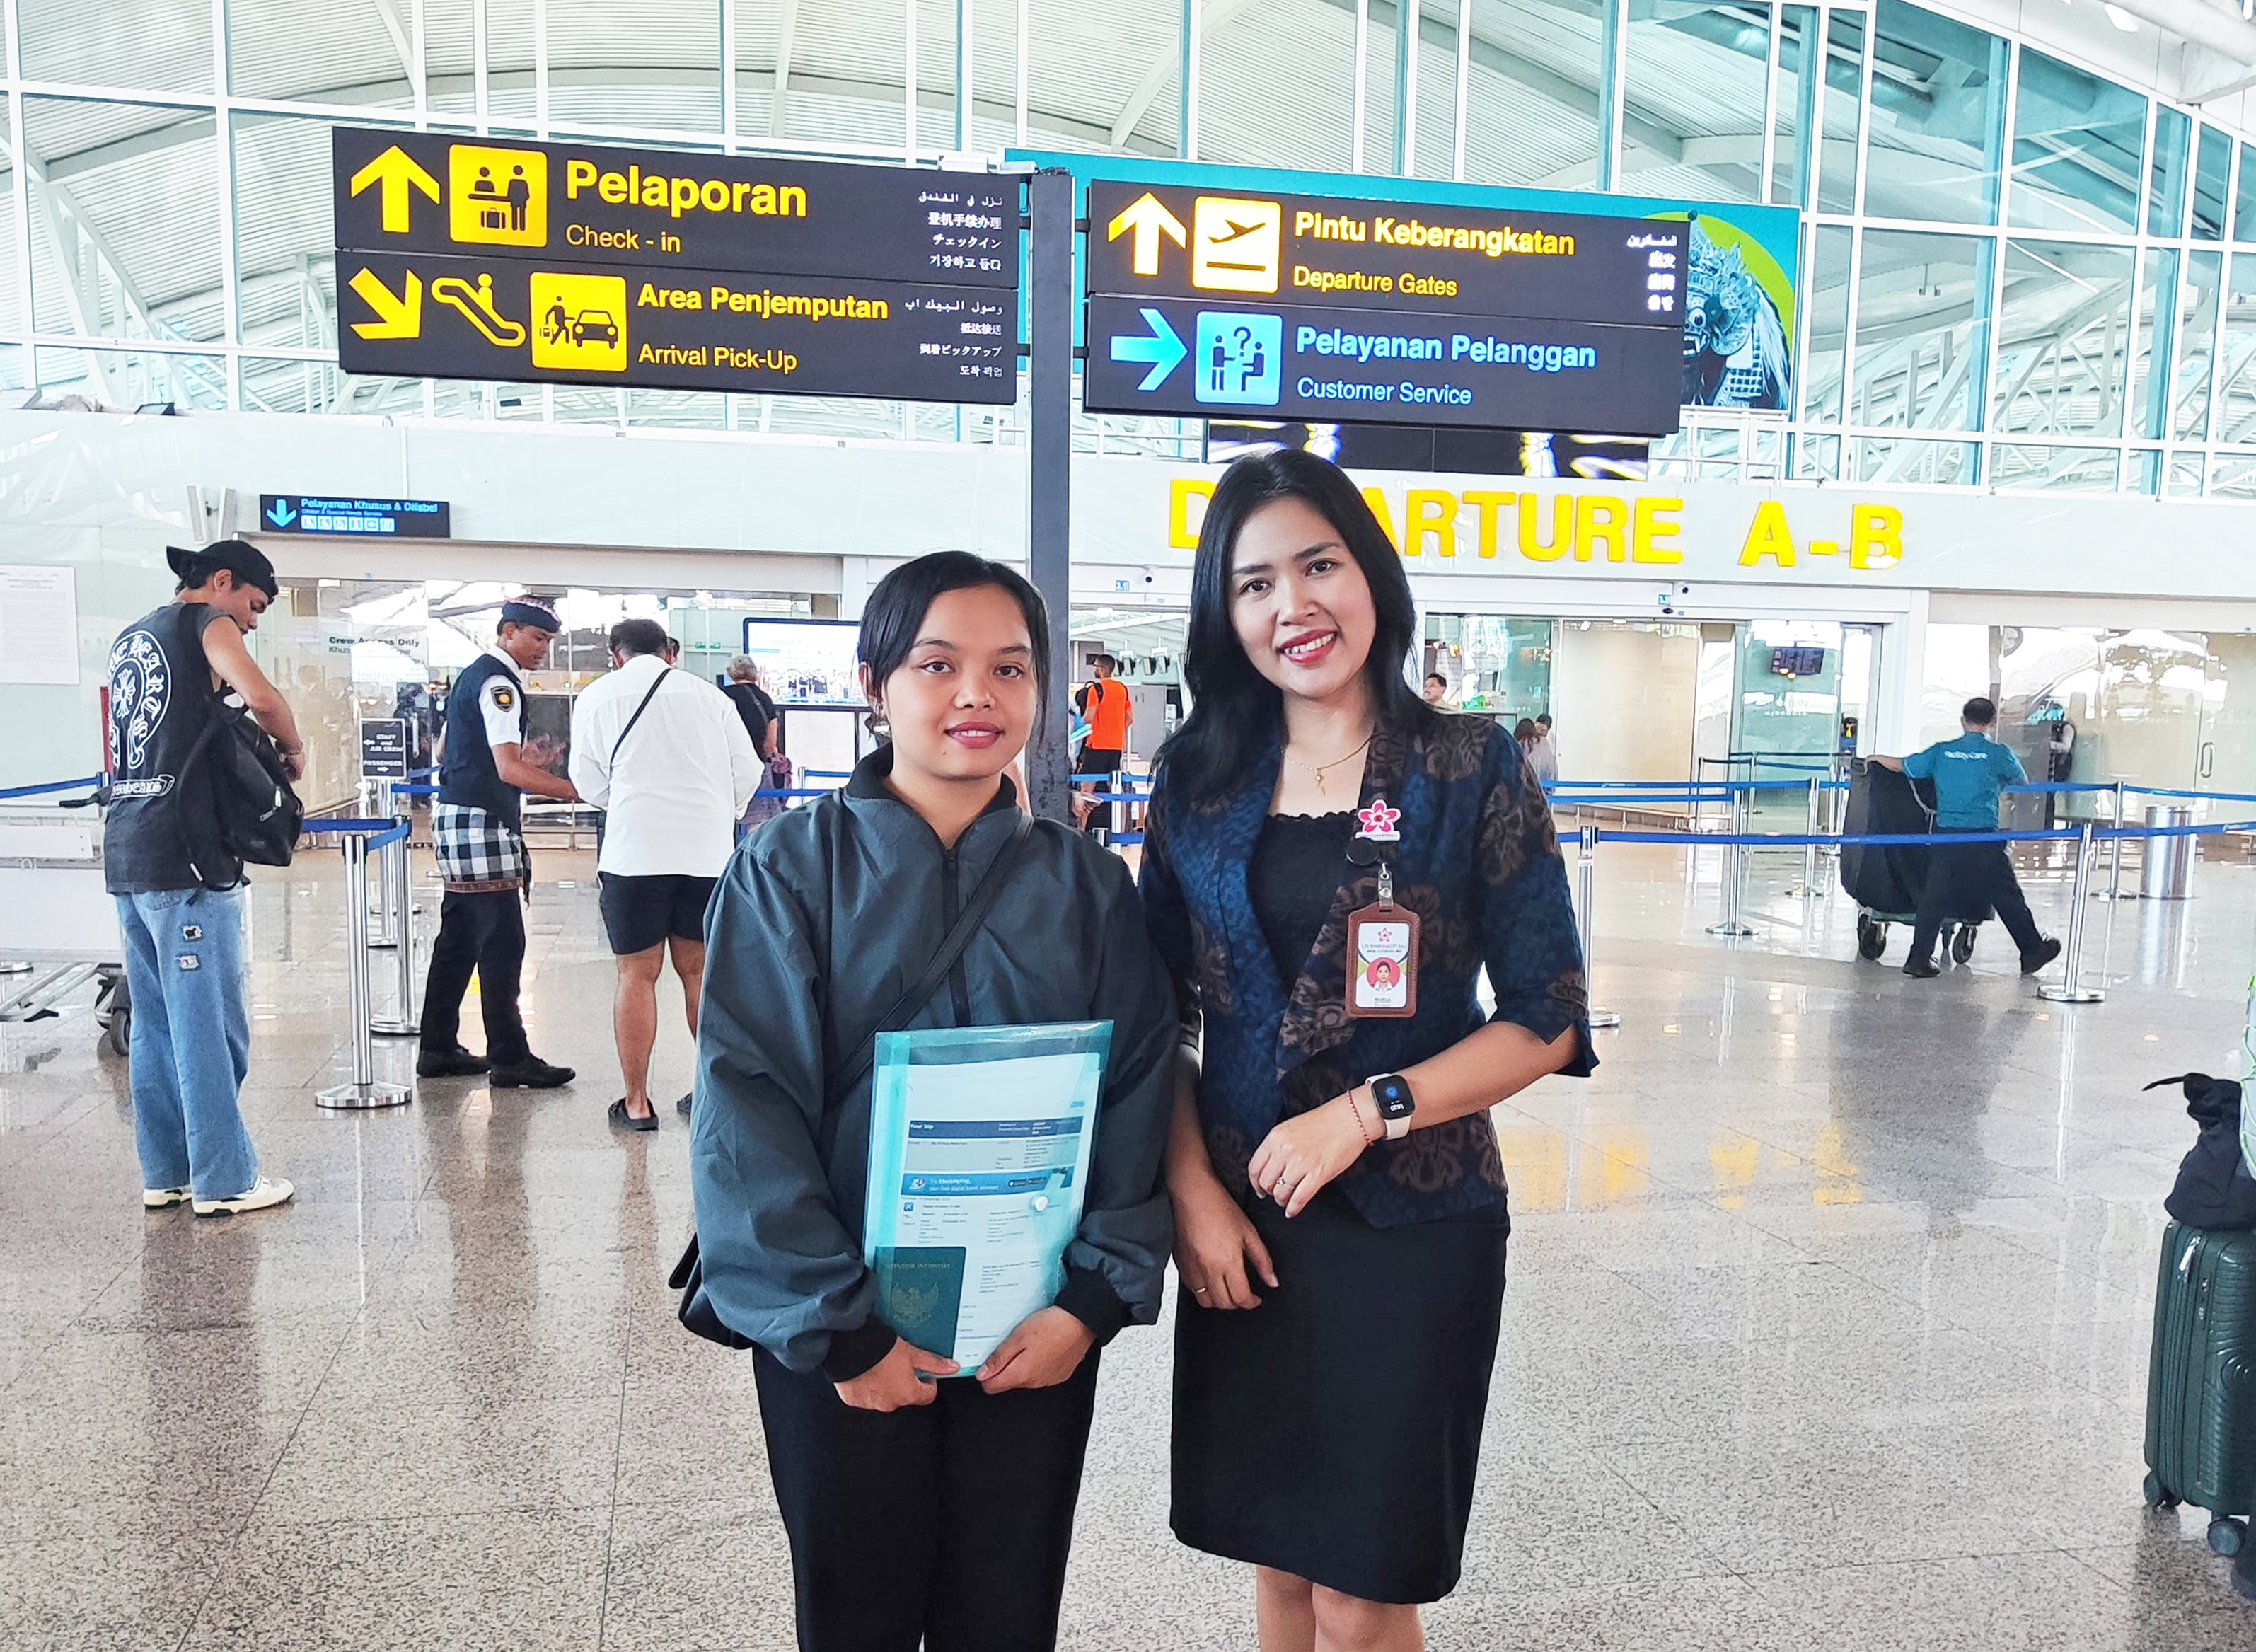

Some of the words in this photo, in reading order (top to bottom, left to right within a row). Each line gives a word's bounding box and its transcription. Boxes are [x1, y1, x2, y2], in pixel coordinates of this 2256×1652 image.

[567, 160, 806, 218] Pelaporan
[567, 225, 639, 250] Check
[661, 232, 681, 253] in
[932, 233, 1002, 248] チェックイン
[1294, 211, 1366, 242] Pintu
[1375, 218, 1575, 257] Keberangkatan
[930, 254, 976, 269] 기장하고
[1293, 265, 1393, 293] Departure
[1399, 273, 1459, 297] Gates
[638, 283, 702, 310] Area
[711, 287, 889, 321] Penjemputan
[639, 344, 707, 366] Arrival
[714, 347, 797, 374] Pick-Up
[1297, 326, 1442, 362] Pelayanan
[1452, 335, 1597, 373] Pelanggan
[1297, 376, 1394, 403] Customer
[1399, 382, 1472, 406] Service
[301, 498, 352, 512] Pelayanan
[354, 499, 392, 510] Khusus
